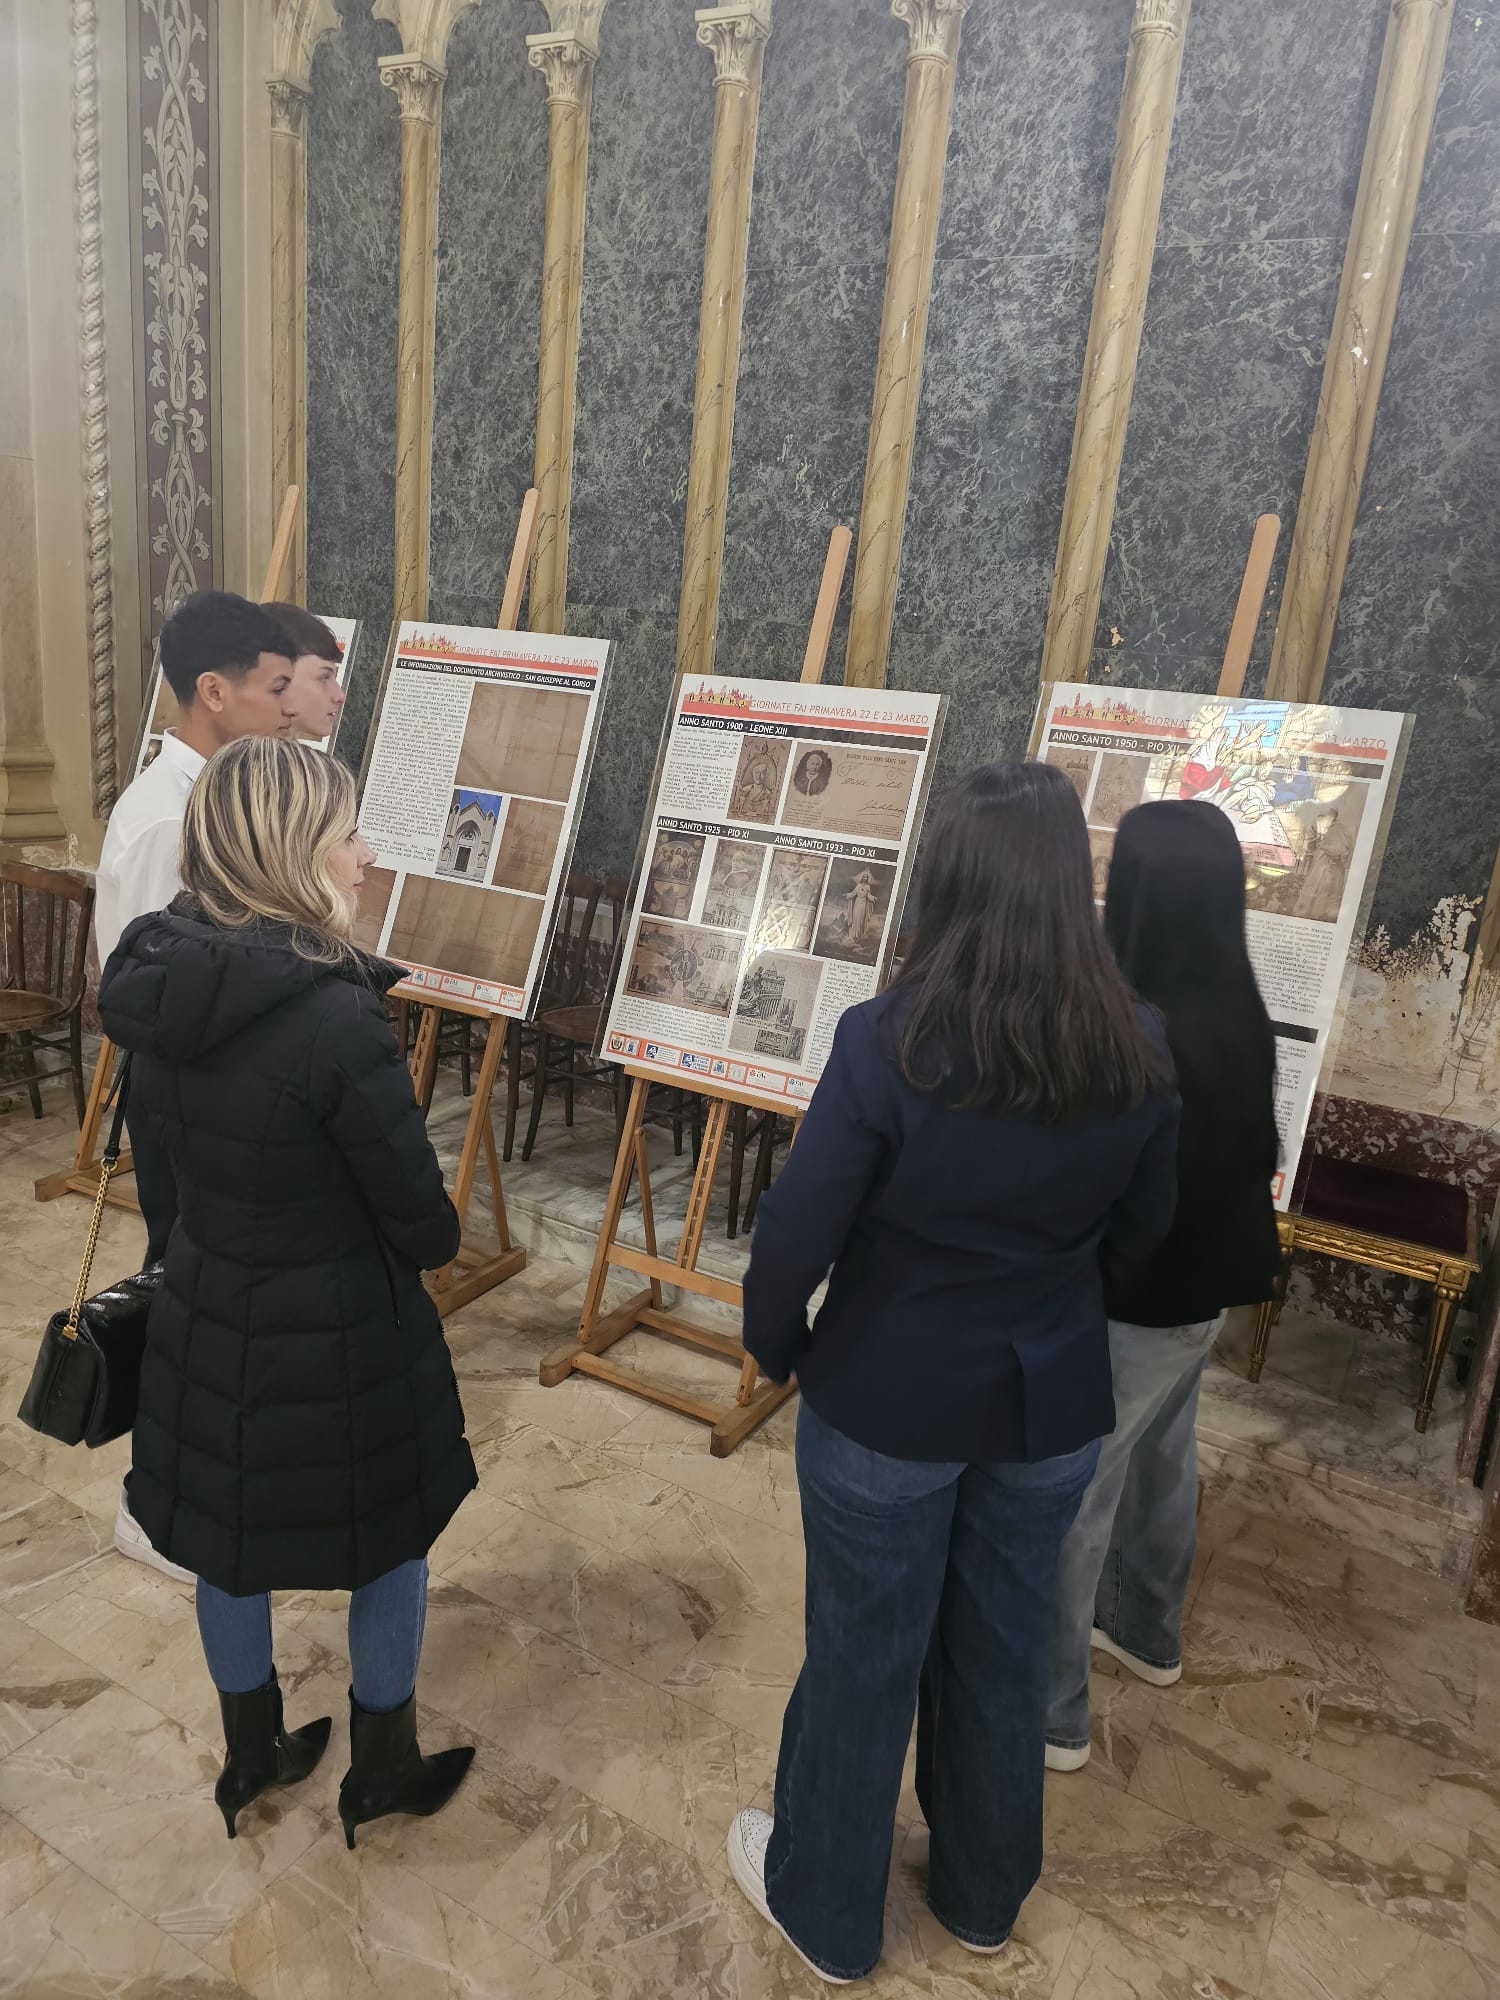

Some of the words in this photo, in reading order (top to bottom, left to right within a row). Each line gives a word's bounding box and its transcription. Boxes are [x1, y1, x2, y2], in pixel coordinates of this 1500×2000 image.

[455, 645, 488, 656] GIORNATE
[490, 649, 500, 657] FAI
[503, 650, 540, 662] PRIMAVERA
[543, 654, 552, 662] 22
[561, 656, 570, 665] 23
[573, 658, 599, 668] MARZO
[408, 661, 442, 671] INFORMAZIONI
[454, 666, 484, 676] DOCUMENTO
[484, 669, 520, 680] ARCHIVISTICO
[536, 675, 563, 685] GIUSEPPE
[572, 679, 590, 688] CORSO
[751, 700, 792, 712] GIORNATE
[794, 704, 807, 713] FAI
[810, 705, 857, 718] PRIMAVERA
[860, 710, 870, 718] 22
[874, 711, 879, 720] E
[882, 712, 892, 721] 23
[896, 713, 928, 724] MARZO
[1144, 716, 1191, 729] GIORNAT
[680, 717, 700, 726] ANNO
[700, 718, 724, 729] SANTO
[726, 721, 744, 731] 1900
[750, 724, 774, 734] LEONE
[775, 727, 788, 736] XIII
[1052, 732, 1079, 742] ANNO
[1081, 734, 1112, 746] SANTO
[1116, 738, 1138, 749] 1950
[1147, 741, 1164, 752] PIO
[1342, 736, 1386, 748] MARZO
[658, 818, 678, 828] ANNO
[679, 821, 702, 832] SANTO
[704, 825, 720, 835] 1925
[728, 828, 740, 837] PIO
[742, 831, 749, 839] XI
[775, 835, 796, 846] ANNO
[797, 838, 822, 850] SANTO
[825, 842, 844, 853] 1933
[851, 846, 866, 856] PIO
[867, 849, 876, 858] XI
